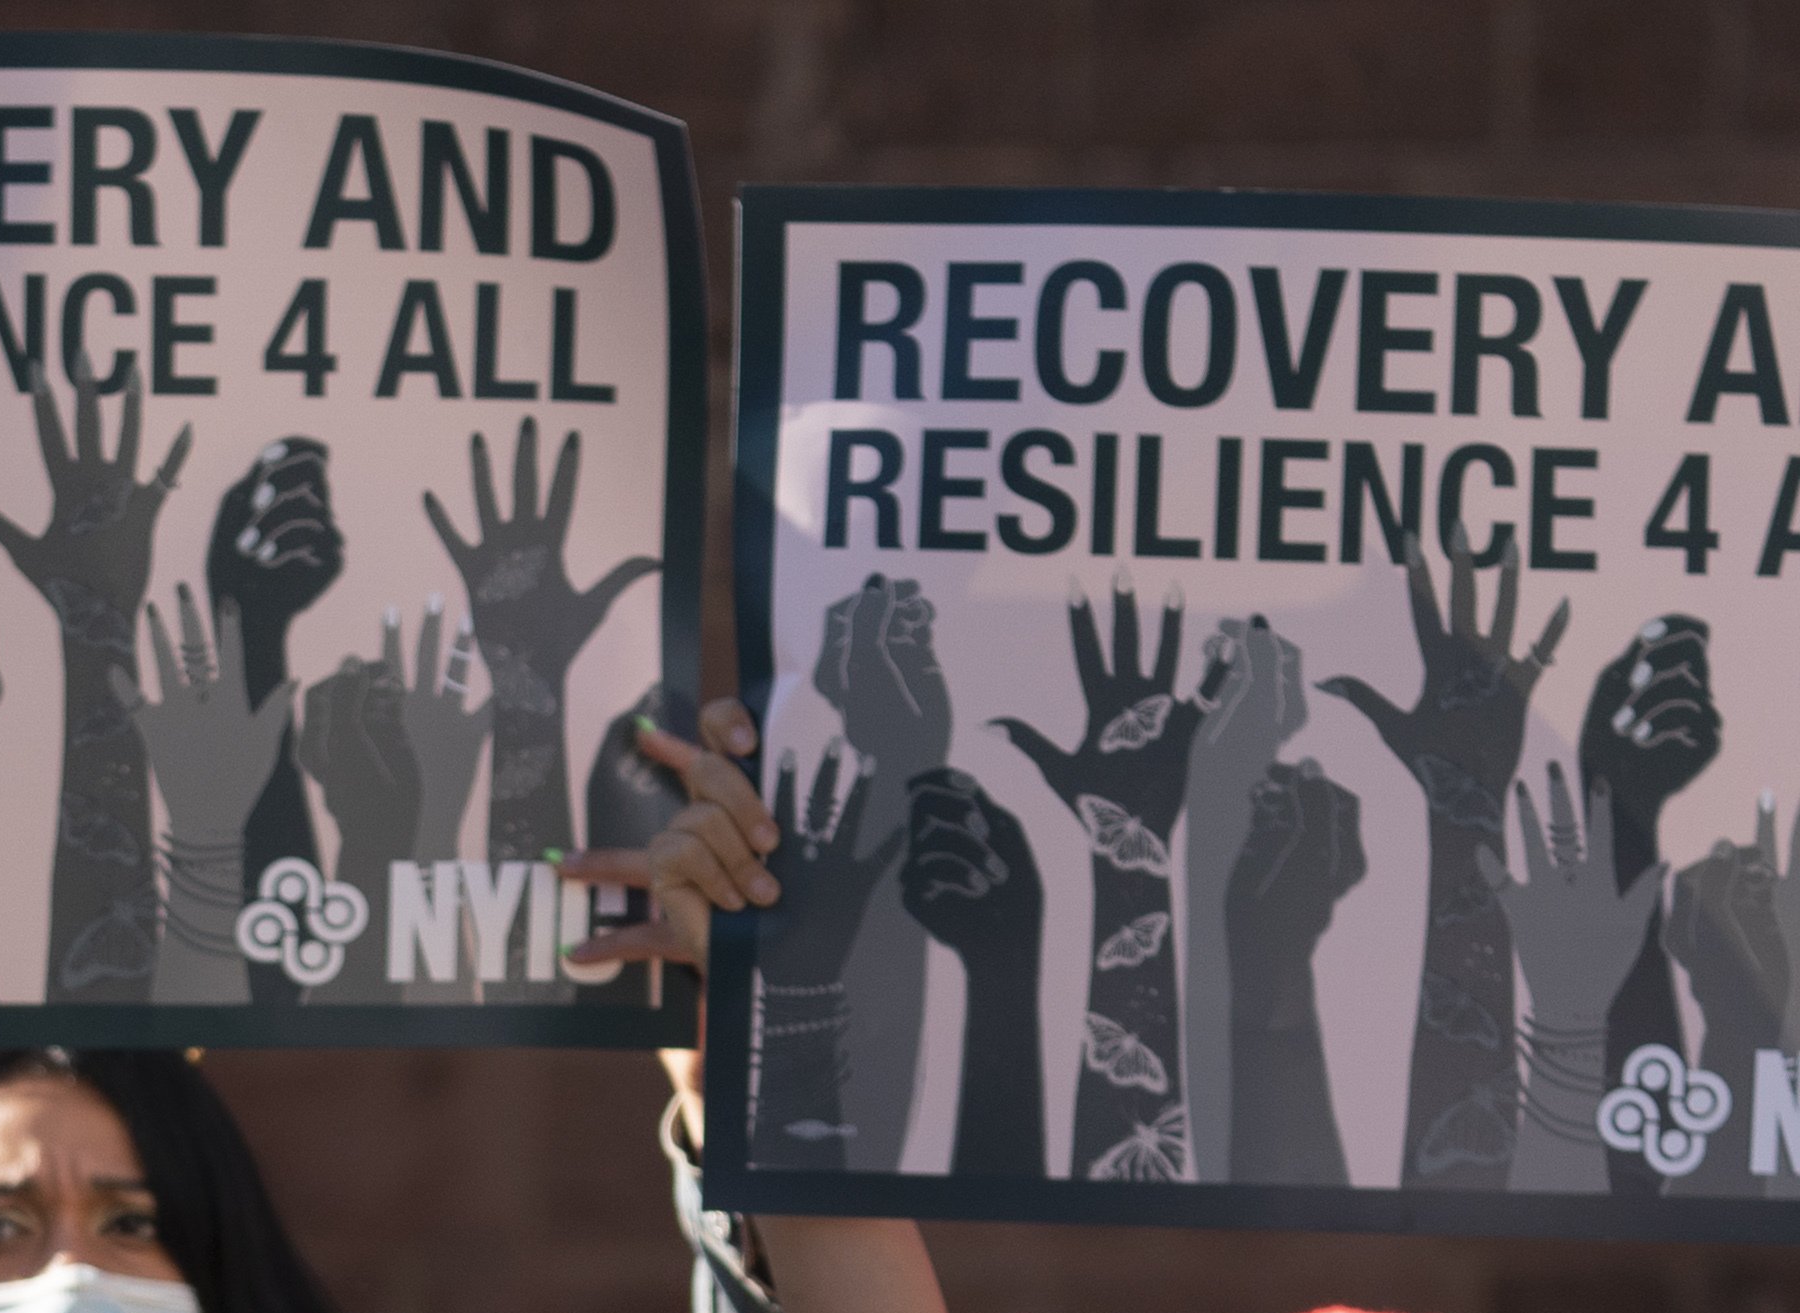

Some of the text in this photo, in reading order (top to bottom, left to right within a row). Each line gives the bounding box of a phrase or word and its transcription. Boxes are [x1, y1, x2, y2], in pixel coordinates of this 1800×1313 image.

[302, 112, 619, 267] AND
[261, 279, 340, 398] 4
[373, 284, 619, 405] ALL
[834, 260, 1650, 422] RECOVERY
[822, 429, 1600, 572] RESILIENCE
[1644, 455, 1720, 576] 4
